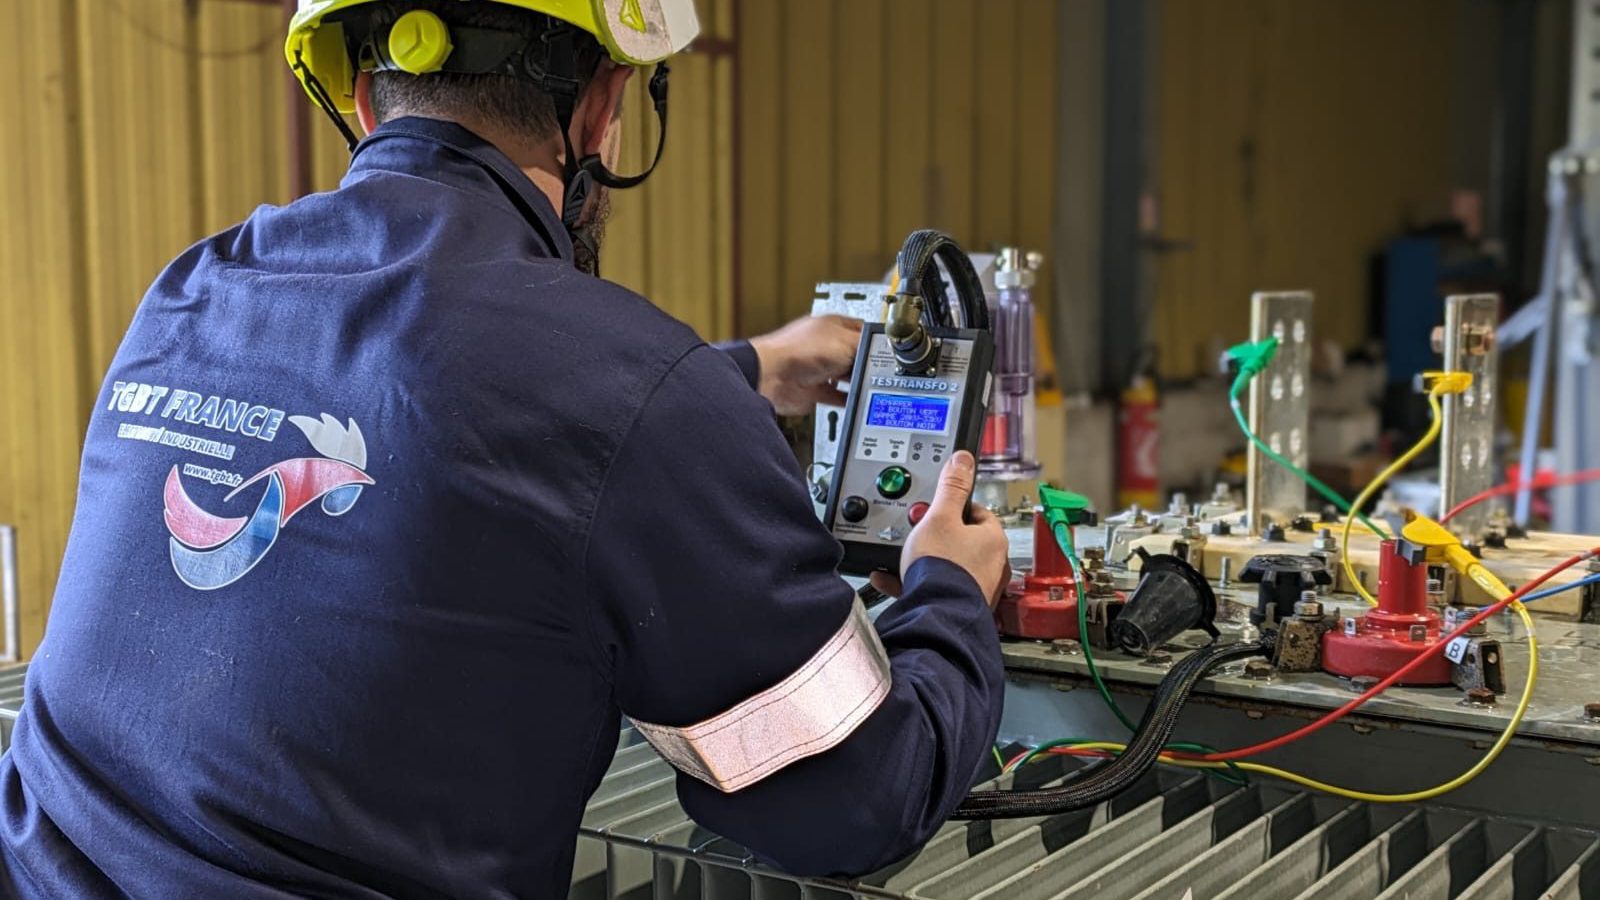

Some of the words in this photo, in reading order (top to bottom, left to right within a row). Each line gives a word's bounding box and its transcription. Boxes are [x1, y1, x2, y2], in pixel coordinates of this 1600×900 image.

[871, 377, 947, 390] TESTRANSFO
[951, 383, 959, 392] 2
[108, 381, 169, 415] TGBT
[161, 389, 285, 442] FRANCE
[183, 463, 243, 487] www.tgbt.fr
[1448, 642, 1460, 658] B
